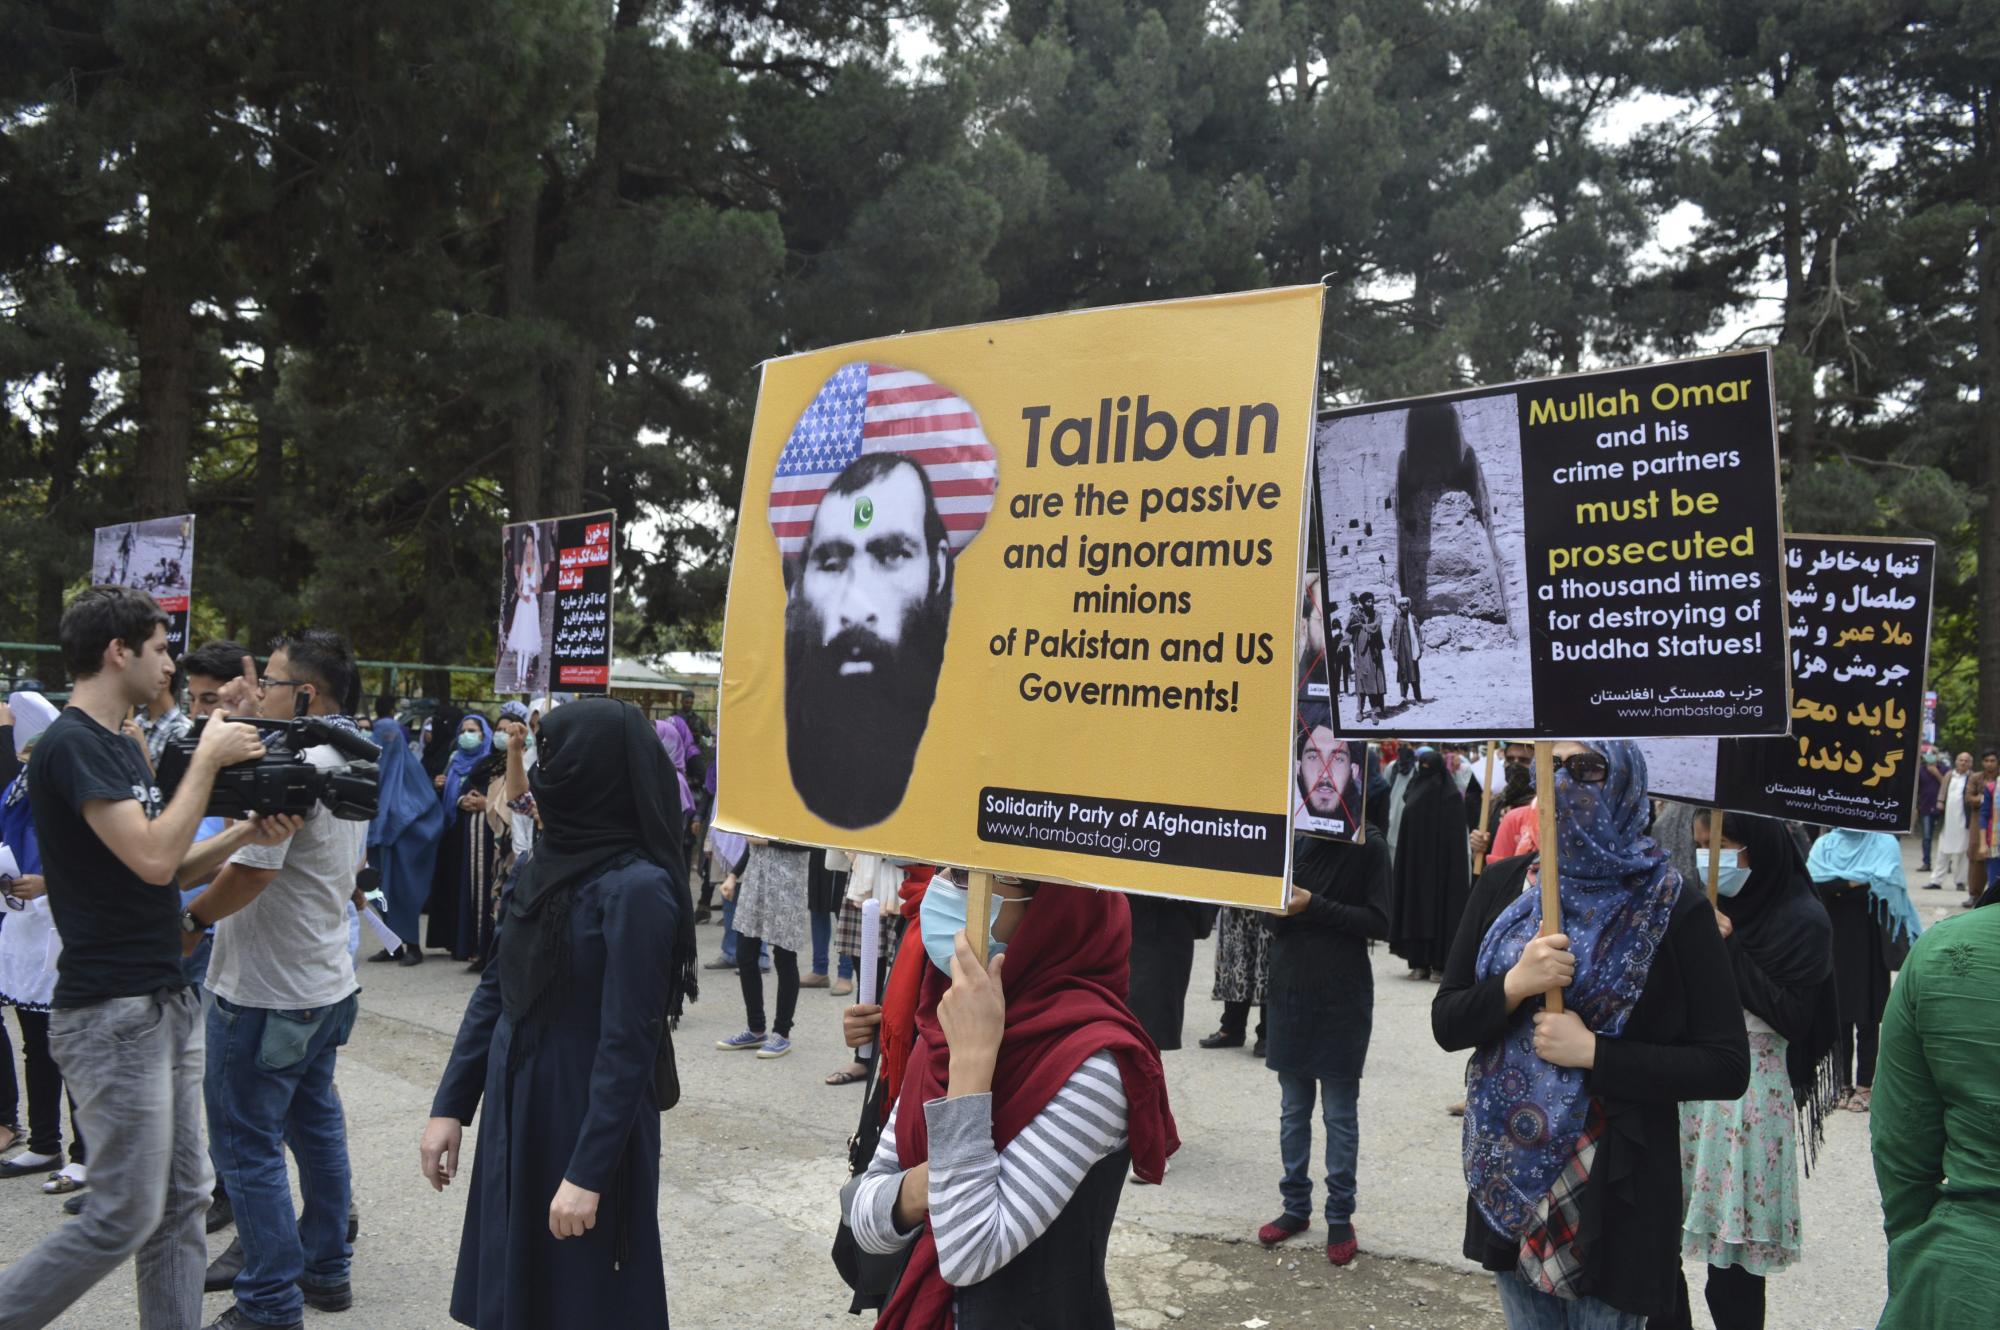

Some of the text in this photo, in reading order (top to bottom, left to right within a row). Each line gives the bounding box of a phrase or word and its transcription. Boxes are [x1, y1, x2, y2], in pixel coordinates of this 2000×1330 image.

[1529, 379, 1752, 426] Mullah Omar
[1022, 394, 1280, 468] Taliban
[1596, 420, 1689, 449] and his
[1552, 450, 1741, 484] crime partners
[1010, 475, 1281, 522] are the passive
[1576, 488, 1720, 524] must be
[1004, 534, 1273, 577] and ignoramus
[1548, 526, 1755, 576] prosecuted
[1885, 553, 1920, 578] تنها
[1073, 583, 1192, 614] minions
[1538, 570, 1762, 600] a thousand times
[1841, 584, 1916, 613] صلصال
[1548, 599, 1761, 631] for destroying of
[1822, 591, 1836, 612] و
[989, 627, 1274, 665] of Pakistan and US
[1551, 632, 1763, 661] Buddha Statues!
[1813, 625, 1828, 646] و
[1833, 625, 1875, 647] عمر
[1881, 620, 1913, 645] ملا
[1792, 649, 1911, 687] جرمش هزا
[1019, 672, 1240, 713] Governments!
[1590, 685, 1764, 705] حزب همبستگی افغانستان
[1617, 703, 1764, 719] www.hambastagi.org
[1790, 687, 1907, 738] باید محا
[1797, 736, 1905, 786] گردند!
[1765, 783, 1900, 810] حزب همبستگی افغانستان
[1785, 799, 1898, 823] www.hambastagi.org
[986, 795, 1267, 841] Solidarity Party of Afghanistan
[986, 820, 1161, 857] www.hambastagi.org
